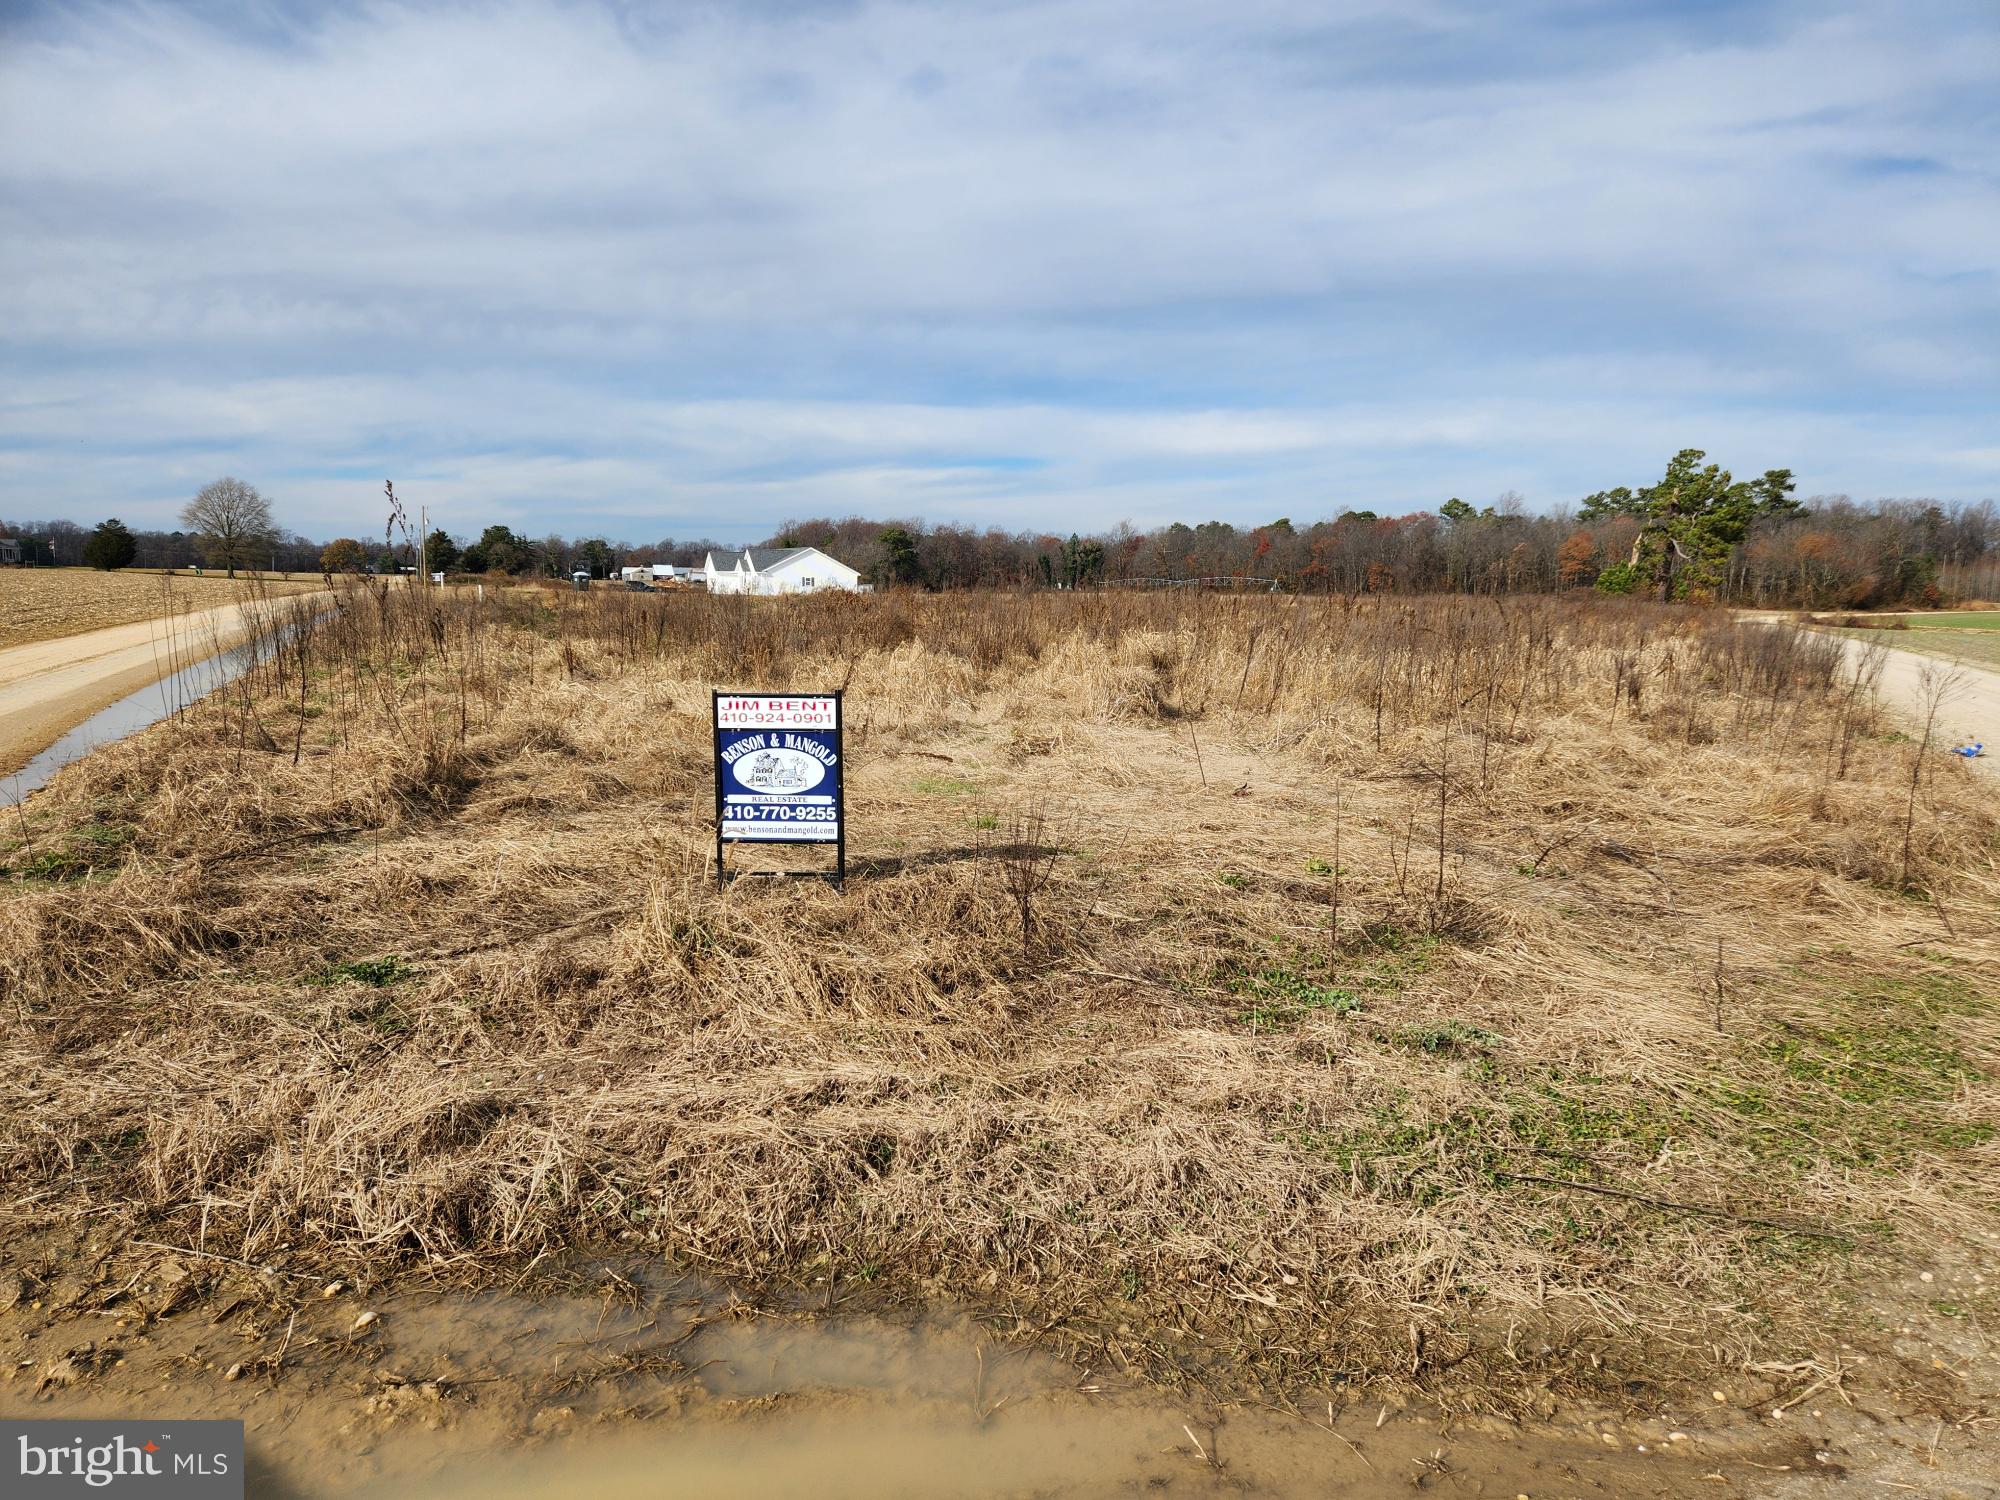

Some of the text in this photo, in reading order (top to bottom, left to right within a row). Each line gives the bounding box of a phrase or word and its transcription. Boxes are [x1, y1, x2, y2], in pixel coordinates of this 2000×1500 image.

[721, 701, 832, 711] JIM BENT
[720, 713, 832, 723] 410-924-0901
[721, 733, 837, 767] BENSON & MANGOLD
[724, 806, 836, 820] 410-770-9255
